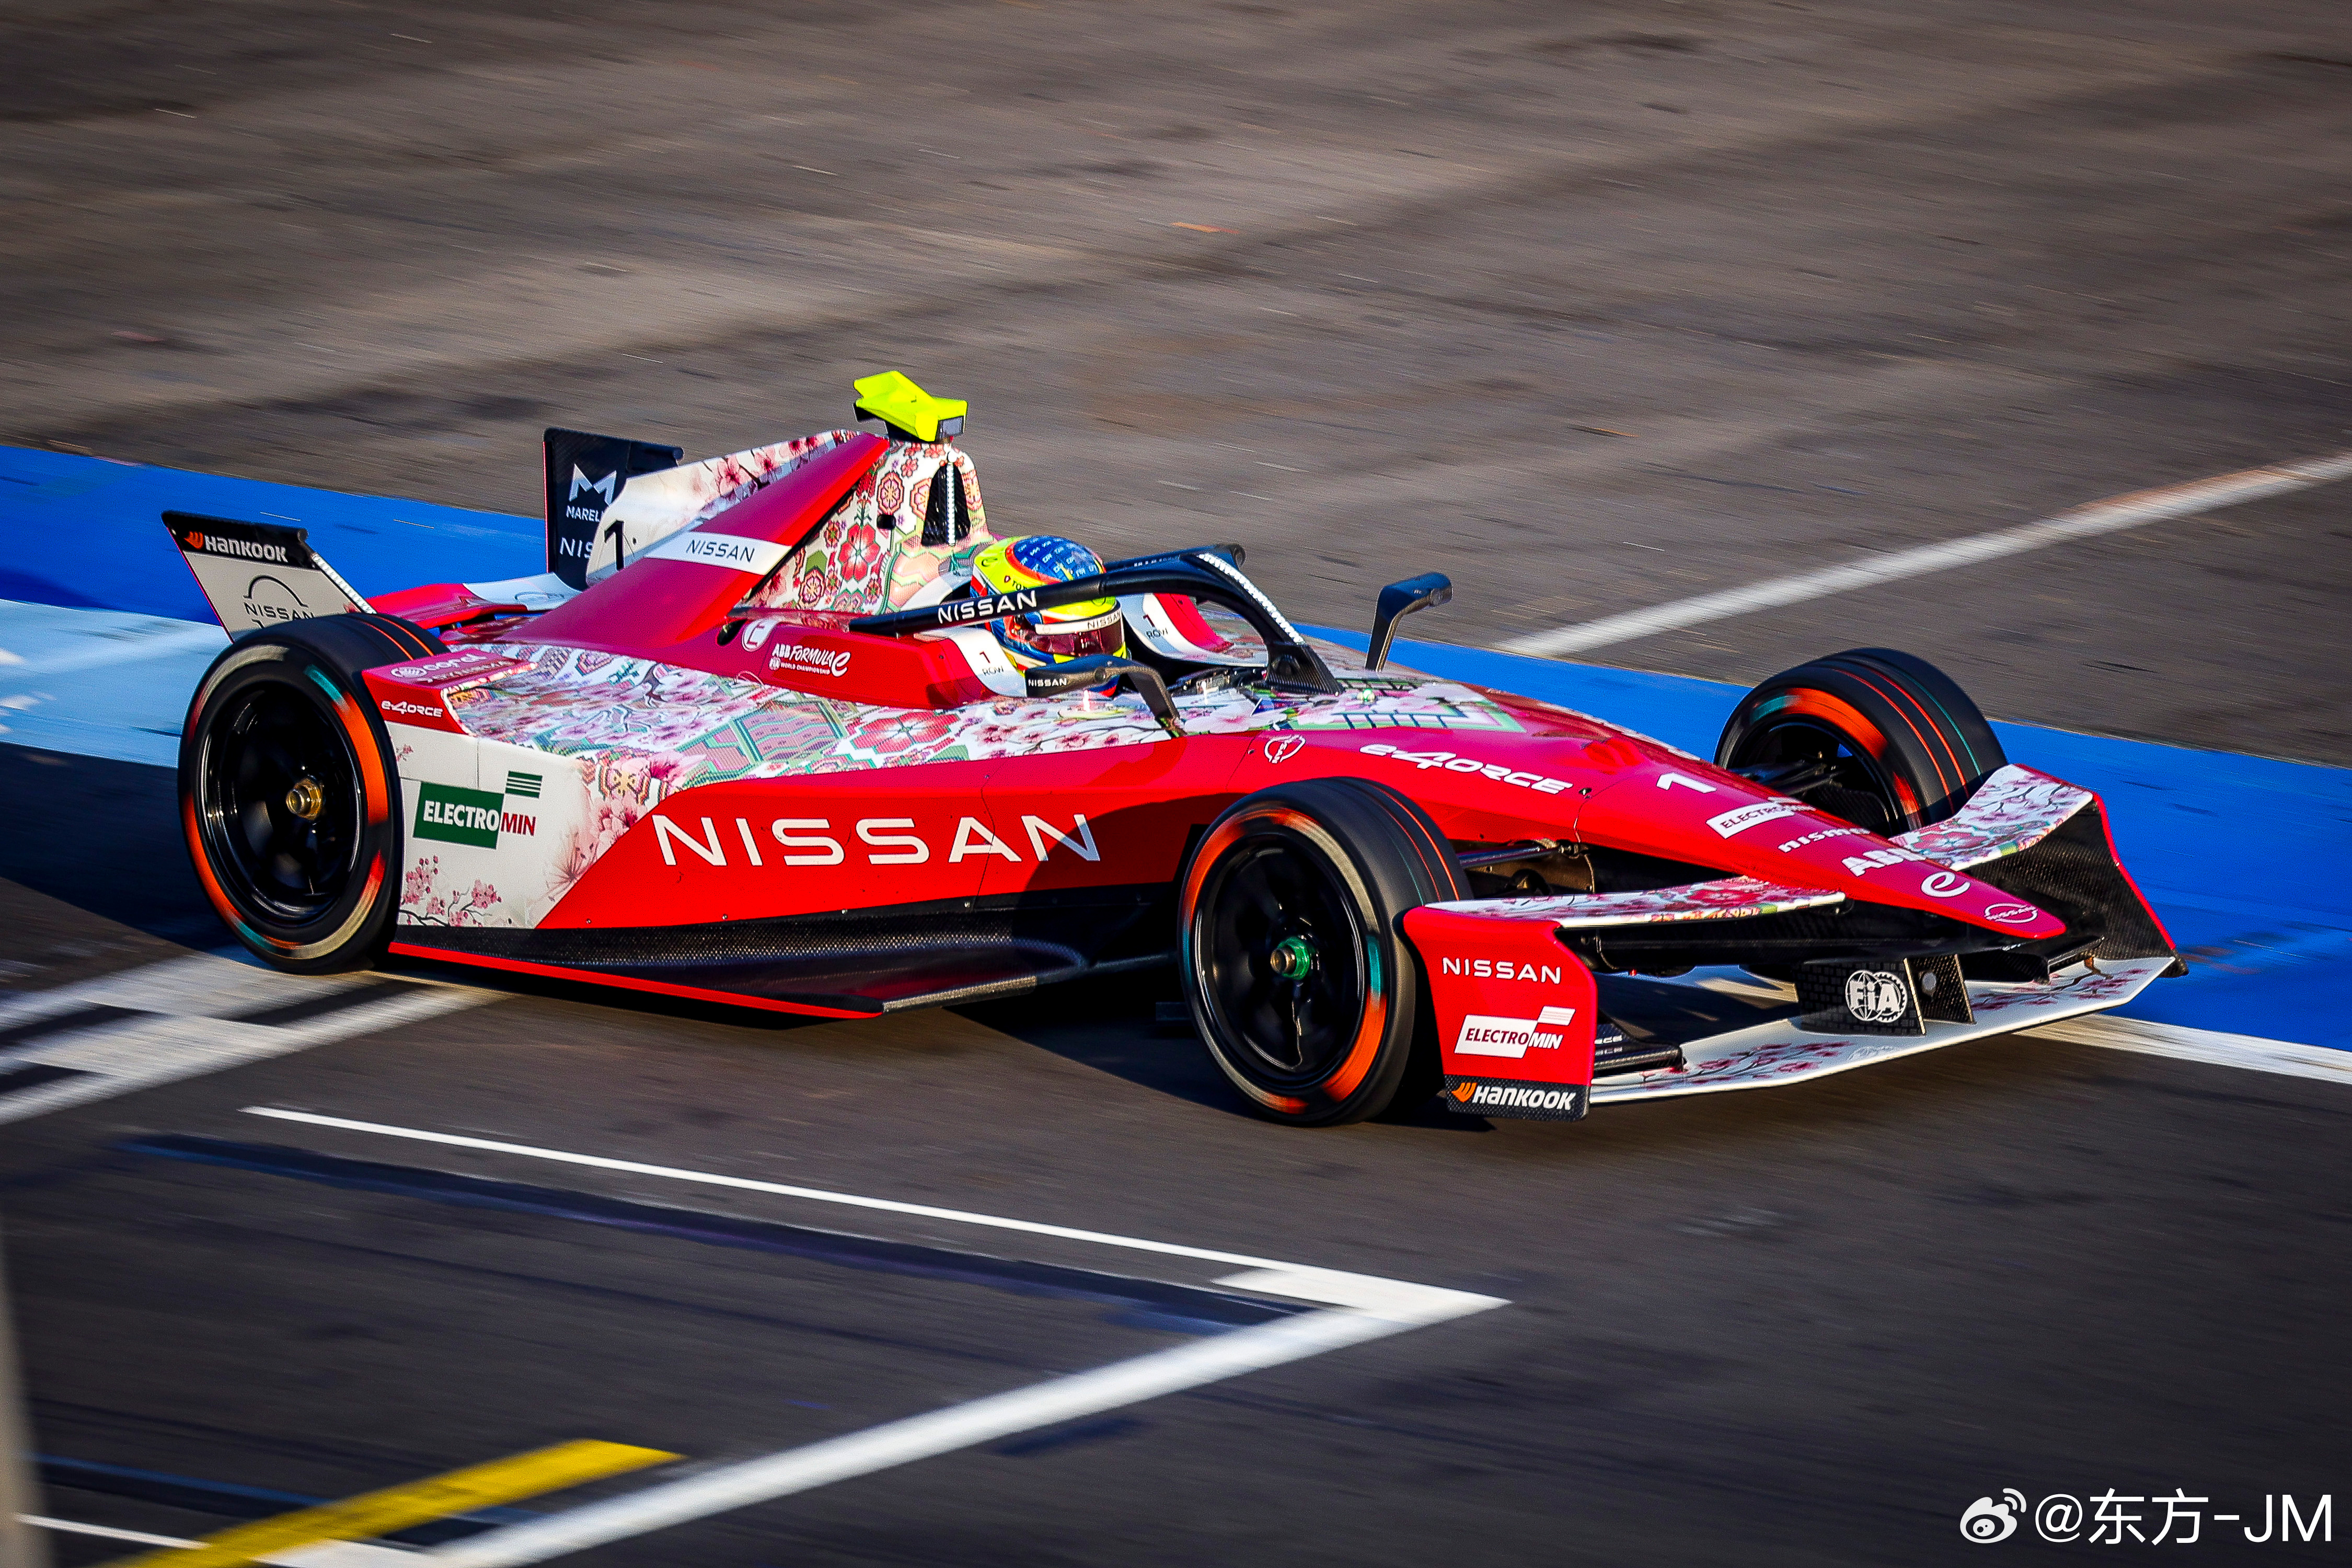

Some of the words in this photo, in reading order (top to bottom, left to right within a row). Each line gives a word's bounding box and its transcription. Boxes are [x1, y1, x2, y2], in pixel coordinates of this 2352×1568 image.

[566, 505, 603, 523] MAREL
[560, 537, 593, 559] NIS
[603, 520, 625, 571] 1
[686, 538, 755, 562] NISSAN
[244, 602, 314, 621] NISSAN
[938, 590, 1037, 624] NISSAN
[1088, 609, 1121, 630] NISSAN
[789, 645, 835, 667] FORMULA
[979, 651, 990, 664] 1
[982, 665, 1004, 676] ROW
[1028, 677, 1067, 687] NISSAN
[1656, 773, 1716, 793] 1
[423, 799, 536, 837] ELECTROMIN
[652, 813, 1100, 867] NISSAN
[1443, 958, 1561, 984] NISSAN
[1465, 1028, 1563, 1050] ELECTROMIN
